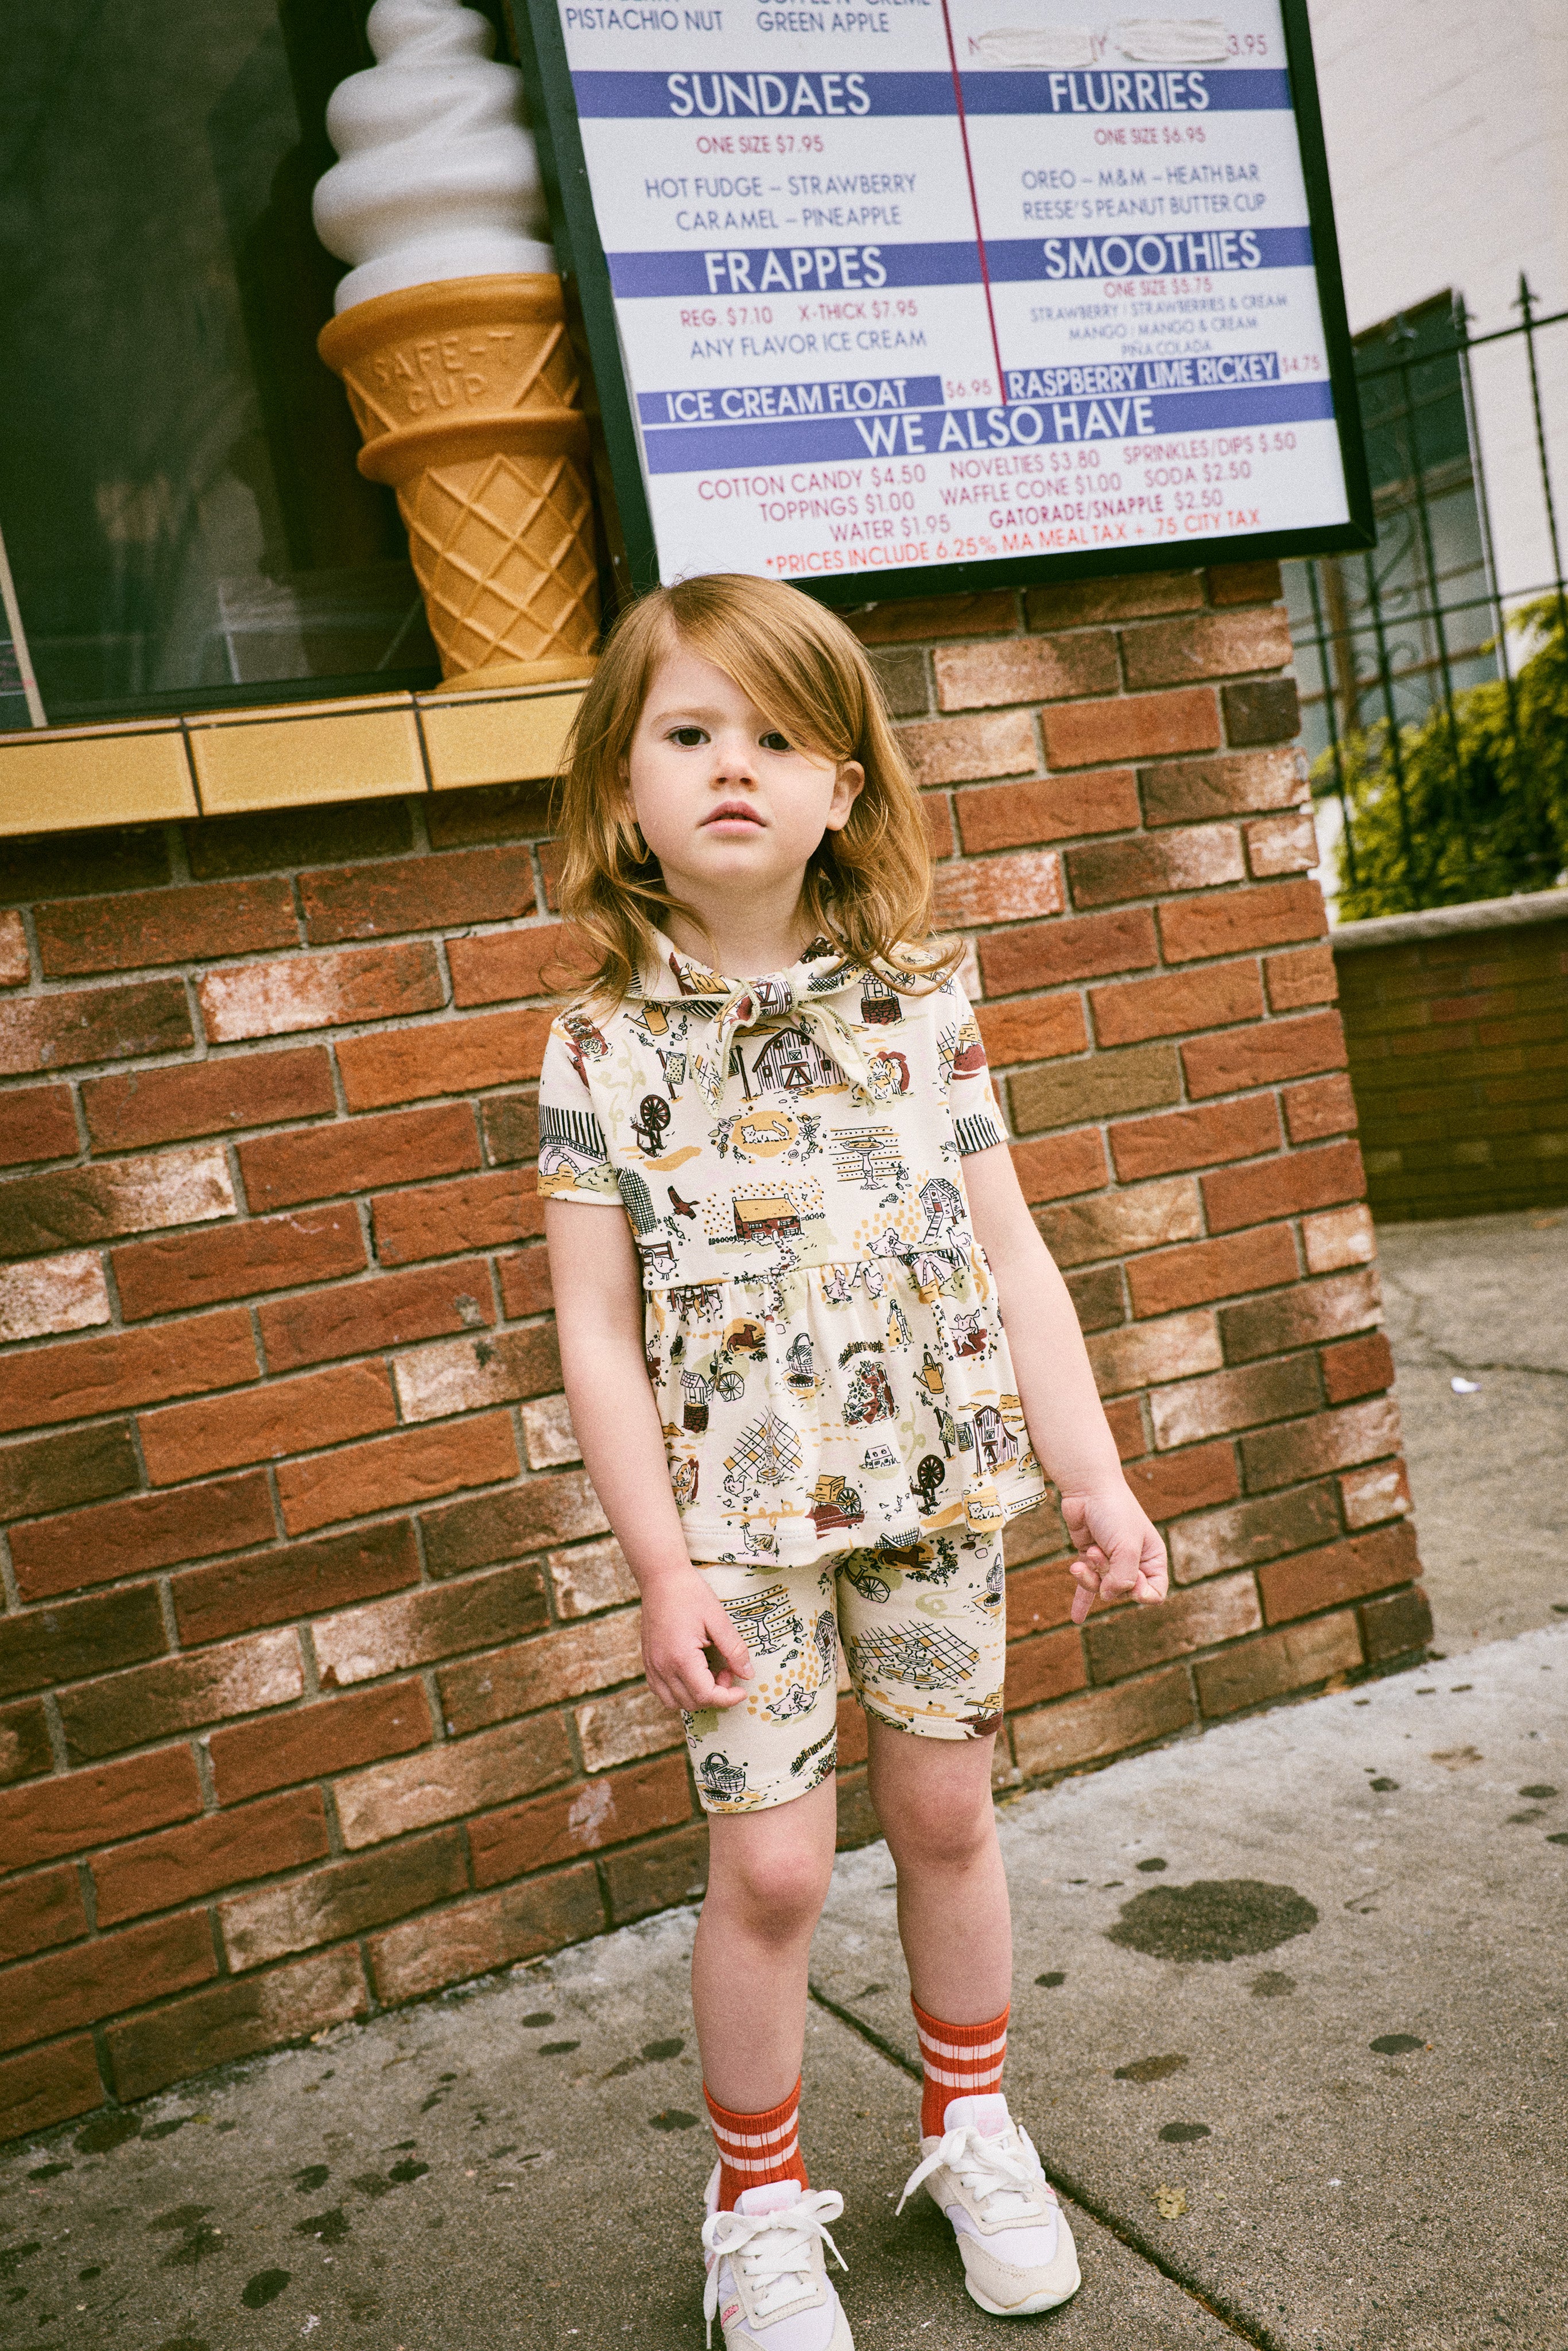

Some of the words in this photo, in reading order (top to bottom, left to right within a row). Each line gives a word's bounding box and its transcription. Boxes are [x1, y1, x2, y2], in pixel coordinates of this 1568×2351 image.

[565, 7, 678, 30] PISTACHIO
[684, 10, 721, 31] NUT
[756, 11, 824, 32] GREEN
[832, 12, 889, 33] APPLE
[667, 73, 871, 116] SUNDAES
[1047, 72, 1210, 112] FLURRIES
[696, 136, 734, 154] ONE
[739, 135, 770, 154] SIZE
[776, 134, 824, 154] $7.95
[1095, 128, 1126, 145] ONE
[1131, 127, 1158, 144] SIZE
[1163, 126, 1205, 144] $6.95
[645, 177, 688, 199] HOT
[694, 176, 762, 197] FUDGE
[788, 173, 915, 196] STRAWBERRY
[1022, 169, 1076, 189] OREO
[1099, 168, 1146, 186] M&M
[1167, 165, 1222, 184] HEATH
[1225, 164, 1259, 183] BAR
[676, 209, 778, 231] CARAMEL
[802, 205, 901, 227] PINEAPPLE
[1022, 199, 1093, 220] REESE'S
[1096, 196, 1165, 217] PEANUT
[1170, 193, 1230, 215] BUTTER
[1234, 192, 1266, 212] CUP
[1043, 230, 1263, 278] SMOOTHIES
[704, 247, 887, 293] FRAPPES
[1104, 281, 1135, 298] ONE
[1140, 279, 1166, 296] SIZE
[680, 310, 724, 327] REG.
[727, 306, 773, 327] $7.10
[799, 302, 865, 320] X-THICK
[872, 299, 918, 319] $7.95
[1031, 303, 1118, 322] STRAWBERRY
[1131, 297, 1225, 316] STRAWBERRIES
[1242, 294, 1287, 309] CREAM
[1069, 323, 1127, 339] MANGO
[1138, 319, 1194, 335] MANGO
[1212, 317, 1257, 331] CREAM
[691, 339, 733, 358] ANY
[740, 333, 817, 356] FLAVOR
[822, 331, 851, 352] ICE
[856, 329, 926, 350] CREAM
[1155, 337, 1212, 354] COLADA
[1008, 362, 1138, 399] RASPBERRY
[1144, 359, 1194, 383] LIME
[1197, 353, 1276, 381] RICKEY
[1282, 354, 1321, 373] $4.75
[407, 373, 488, 413] CUP
[666, 391, 714, 423] ICE
[719, 385, 822, 419] CREAM
[826, 379, 907, 410] FLOAT
[946, 379, 992, 398] $6.95
[854, 413, 926, 459] WE
[938, 405, 1046, 453] ALSO
[1052, 396, 1158, 443] HAVE
[697, 476, 785, 501] COTTON
[791, 470, 862, 493] CANDY
[871, 463, 926, 488] $4.50
[950, 453, 1044, 479] NOVELTIES
[1050, 449, 1100, 472] $3.80
[1123, 438, 1255, 465] SPRINKLES/DIPS
[759, 495, 858, 522] TOPPINGS
[865, 490, 915, 515] $1.00
[940, 482, 1010, 506] WAFFLE
[1016, 477, 1069, 500] CONE
[1075, 472, 1121, 496] $1.00
[1144, 466, 1197, 488] SODA
[1203, 460, 1252, 483] $2.50
[830, 519, 894, 542] WATER
[901, 513, 950, 538] $1.95
[988, 494, 1165, 530] GATORADE/SNAPPLE
[1174, 488, 1223, 511] $2.50
[847, 541, 930, 568] INCLUDE
[935, 534, 998, 561] 6.25%
[1000, 531, 1035, 552] MA
[1037, 526, 1089, 549] MEAL
[1091, 522, 1128, 545] TAX
[1182, 513, 1222, 535] CITY
[1225, 508, 1263, 530] TAX
